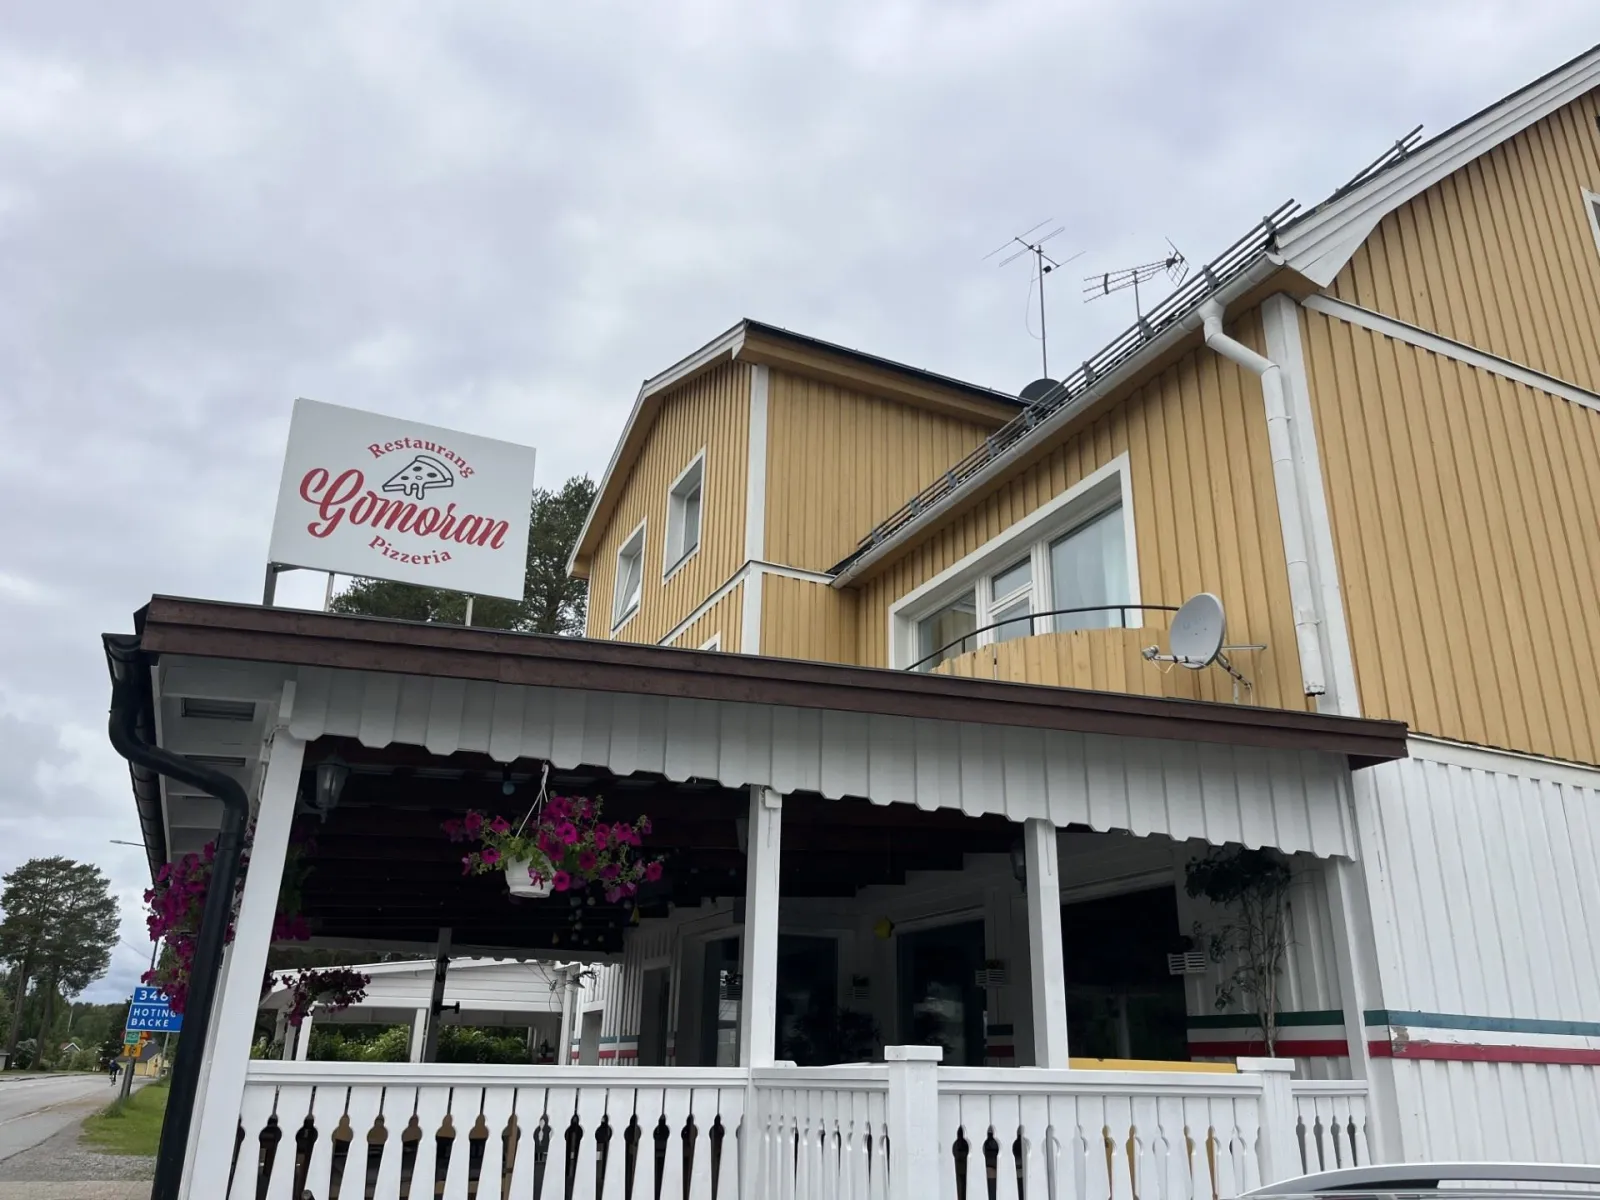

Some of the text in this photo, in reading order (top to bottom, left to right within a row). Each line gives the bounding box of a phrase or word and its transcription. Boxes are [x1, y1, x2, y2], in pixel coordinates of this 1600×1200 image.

[368, 437, 475, 478] Restaurang
[300, 468, 509, 549] Gomoran
[369, 535, 452, 564] Pizzeria
[139, 990, 169, 1001] 346
[131, 1018, 169, 1028] BACKE
[133, 1008, 177, 1018] HOTING
